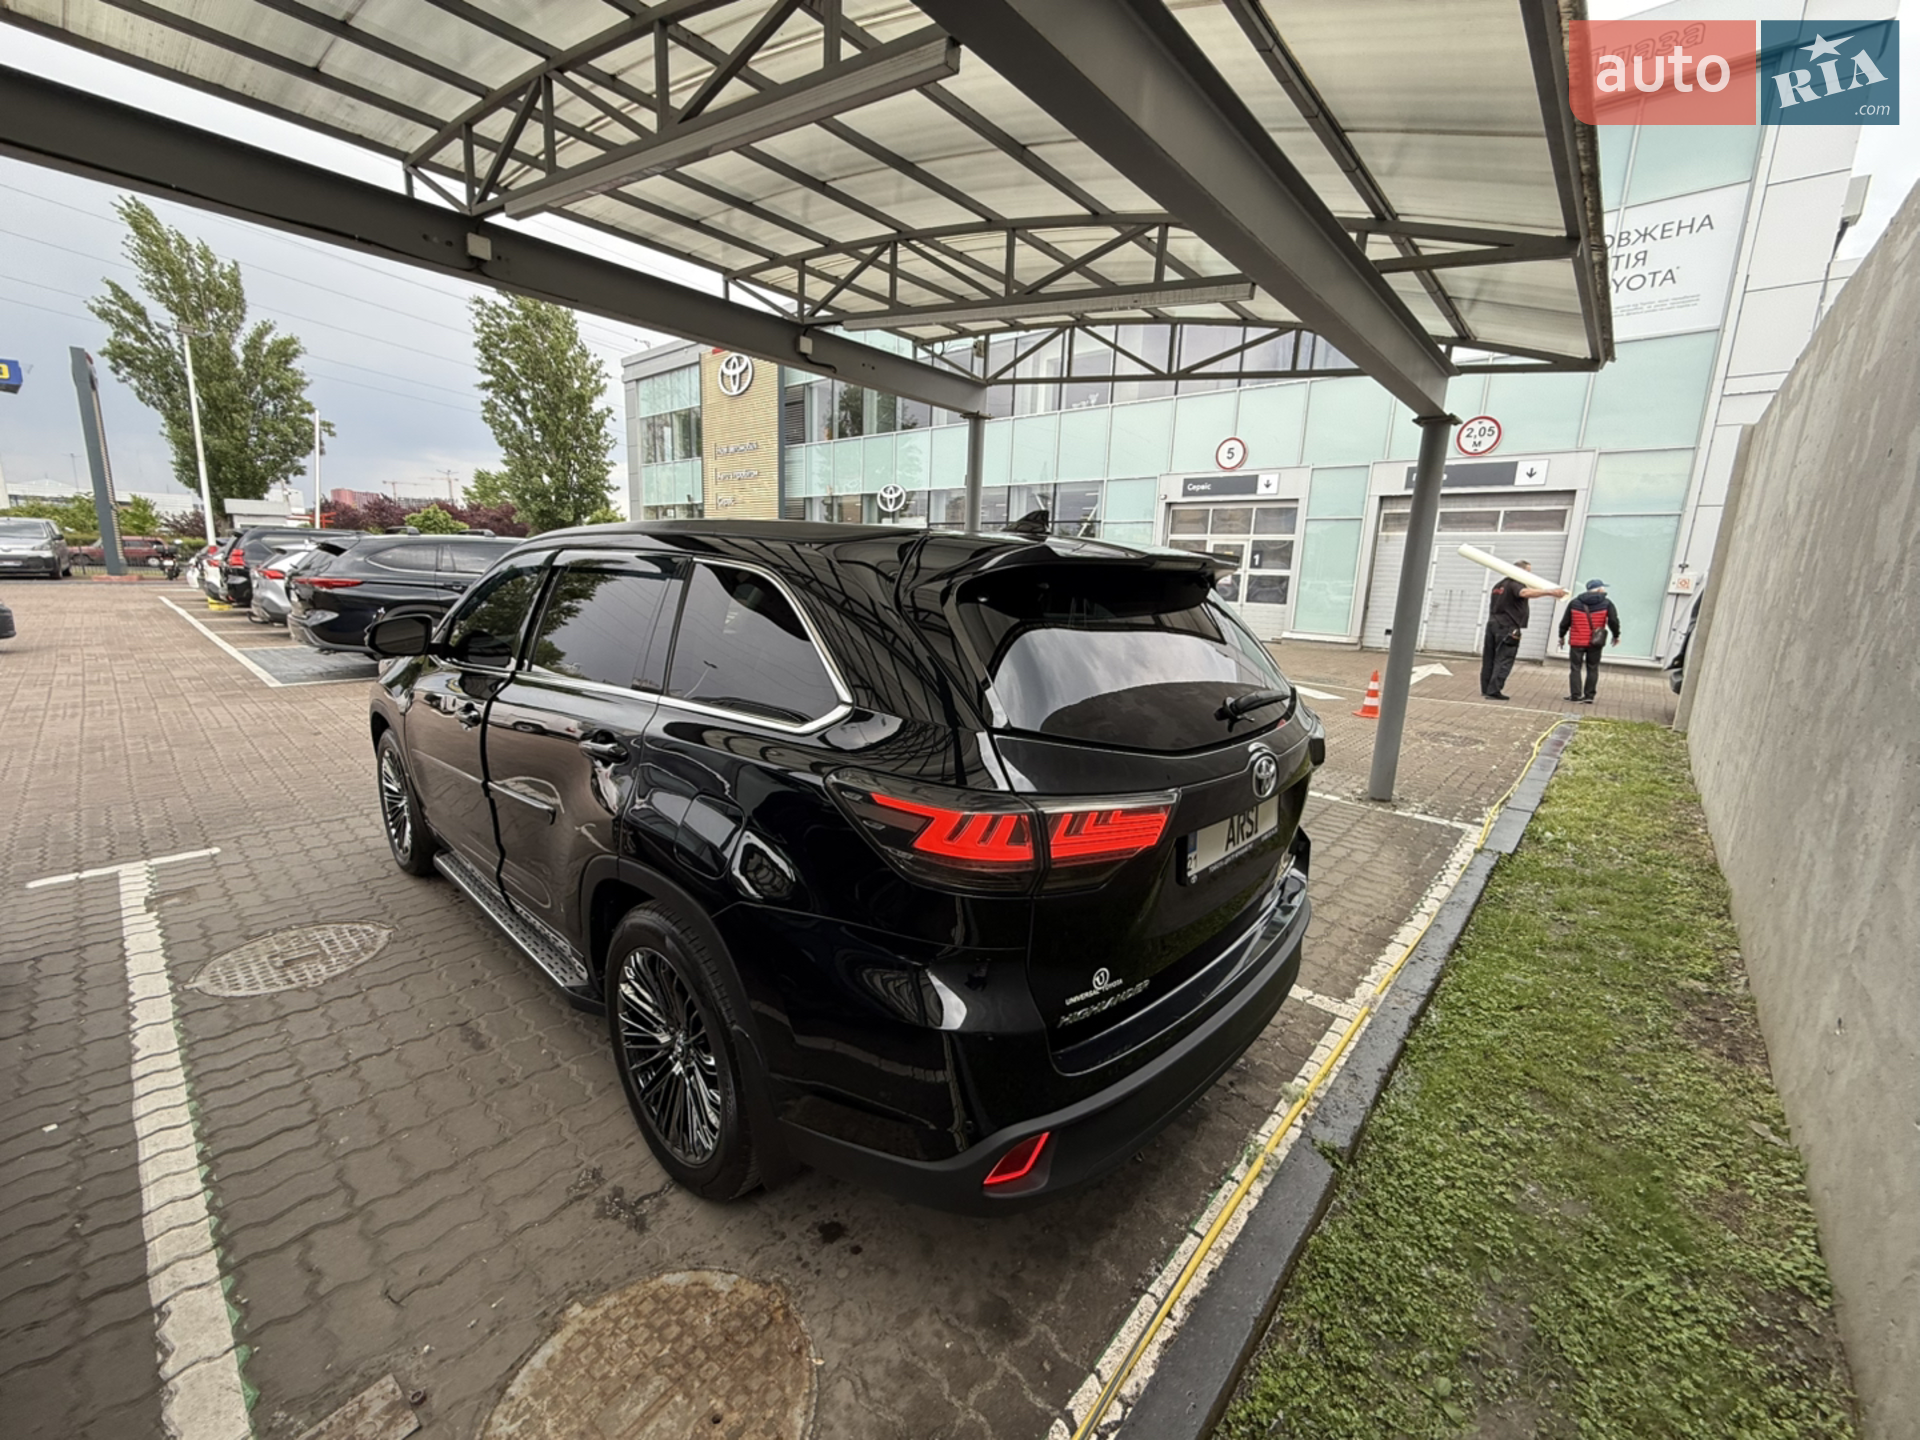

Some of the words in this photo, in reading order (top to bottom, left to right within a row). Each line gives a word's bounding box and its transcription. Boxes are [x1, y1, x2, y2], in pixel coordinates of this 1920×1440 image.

[1612, 250, 1648, 271] ТІЯ
[1465, 426, 1496, 439] 2,05
[1226, 446, 1235, 460] 5
[1253, 554, 1261, 566] 1
[1187, 853, 1198, 871] 21
[1065, 989, 1100, 1006] UNIVERSAL
